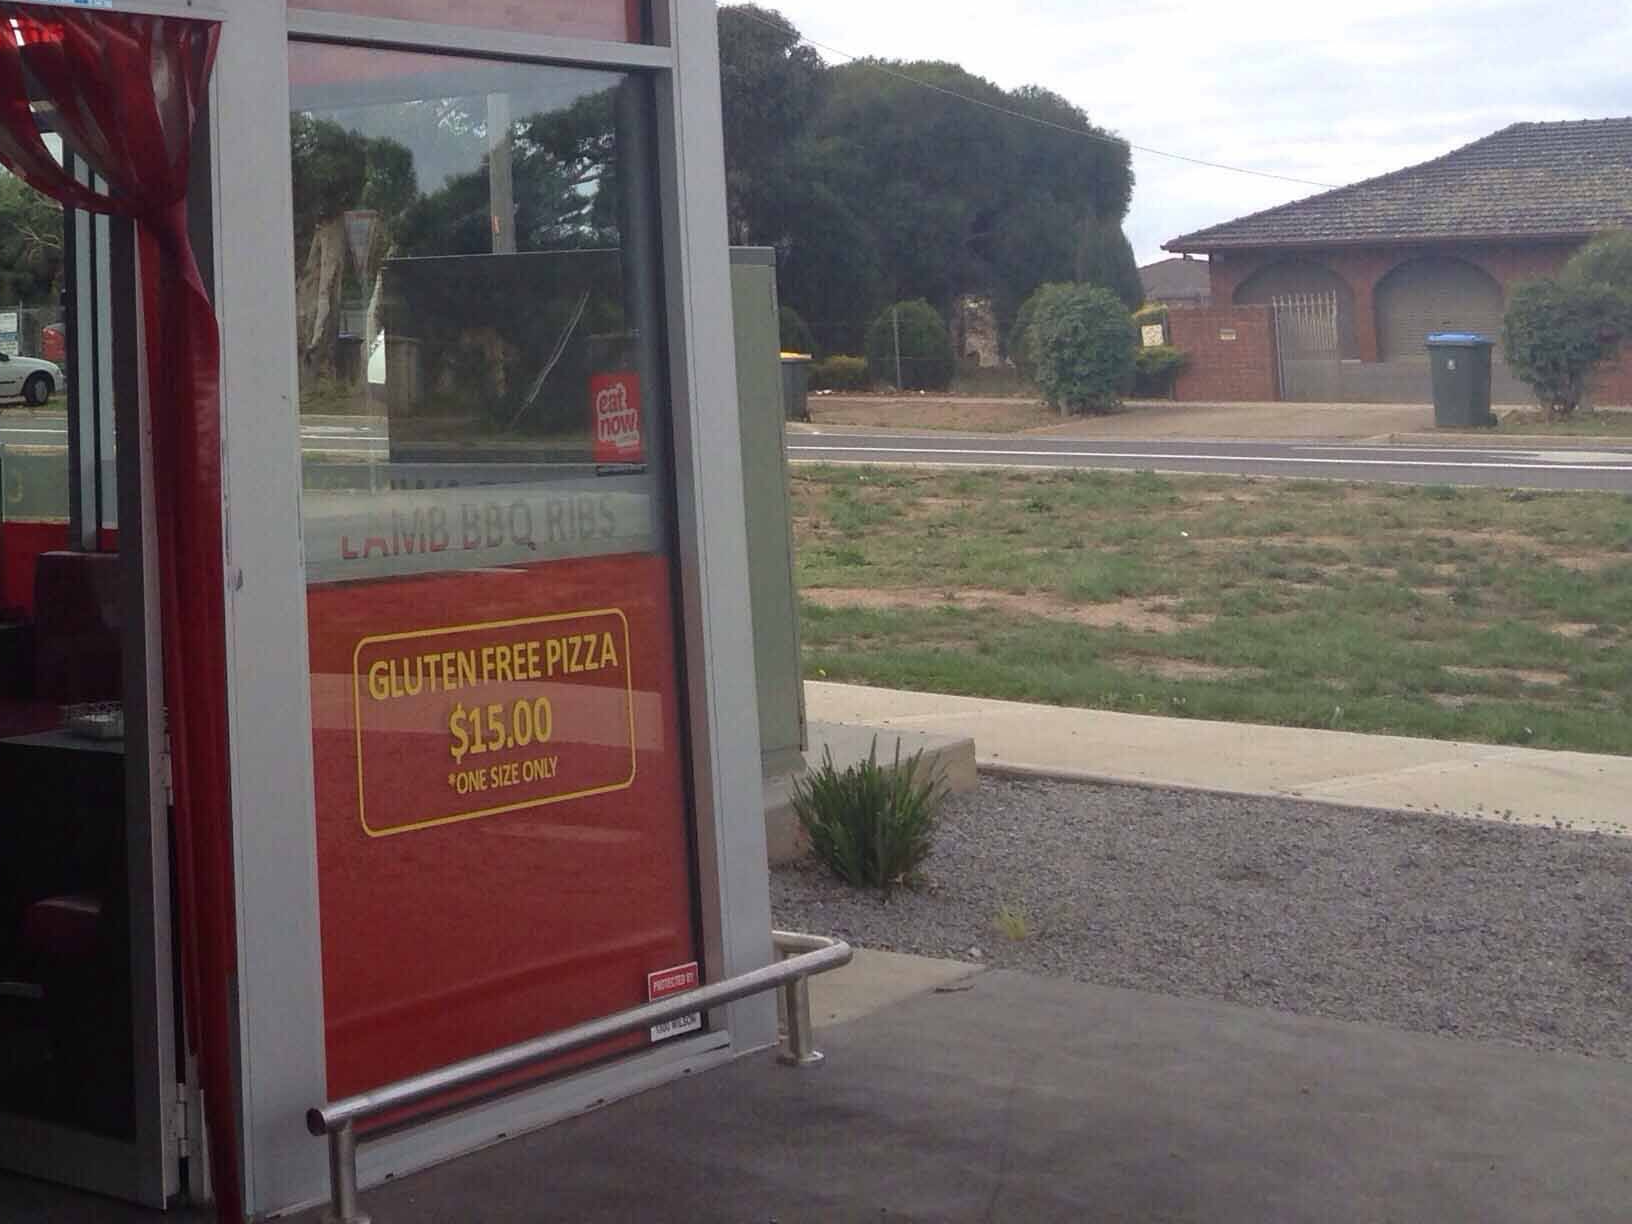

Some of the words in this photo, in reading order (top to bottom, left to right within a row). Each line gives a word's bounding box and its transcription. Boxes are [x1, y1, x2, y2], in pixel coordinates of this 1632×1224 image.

[545, 493, 617, 544] RIBS
[367, 647, 479, 701] GLUTEN
[481, 640, 542, 682] FREE
[545, 631, 619, 676] PIZZA
[448, 695, 554, 764] $15.00
[490, 761, 520, 789] SIZE
[522, 755, 559, 782] ONLY
